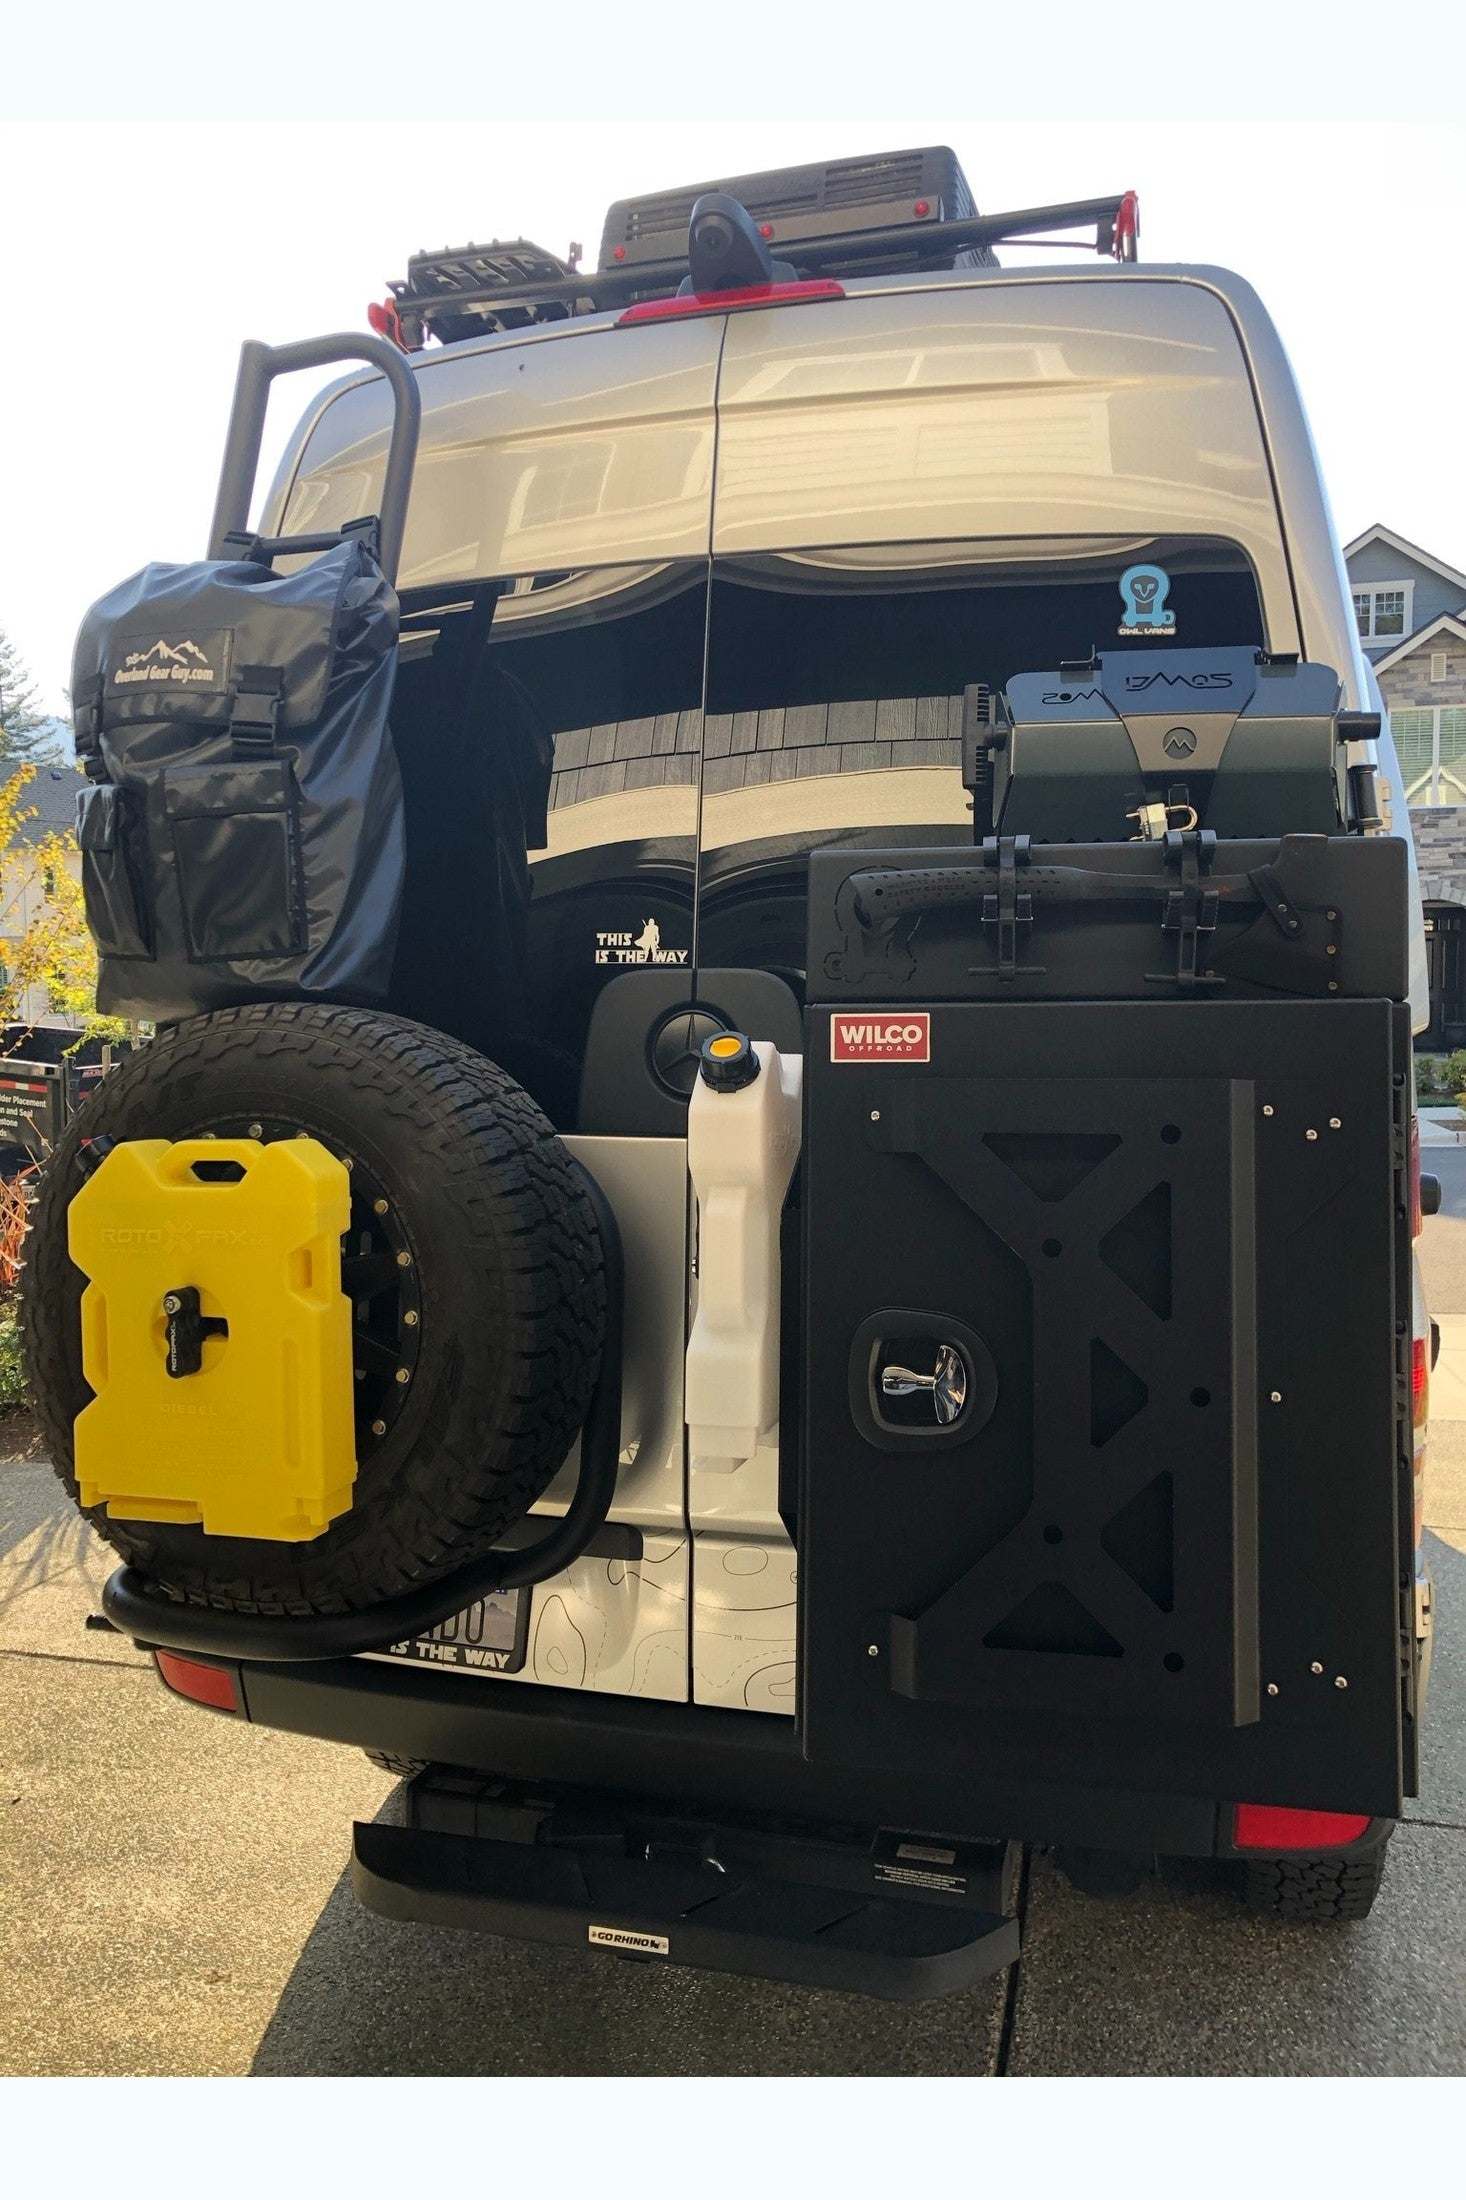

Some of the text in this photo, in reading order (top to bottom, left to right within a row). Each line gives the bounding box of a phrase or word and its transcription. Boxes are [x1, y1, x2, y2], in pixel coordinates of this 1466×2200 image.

[1118, 627, 1176, 635] OWL VANS
[149, 664, 171, 680] Gear
[170, 664, 214, 684] Guy.com
[596, 932, 633, 946] THIS
[595, 949, 689, 963] IS THE WAY
[839, 1024, 923, 1044] WILCO
[415, 1642, 458, 1662] THE
[464, 1649, 511, 1670] WAY
[597, 1931, 649, 1947] GO RHINO
